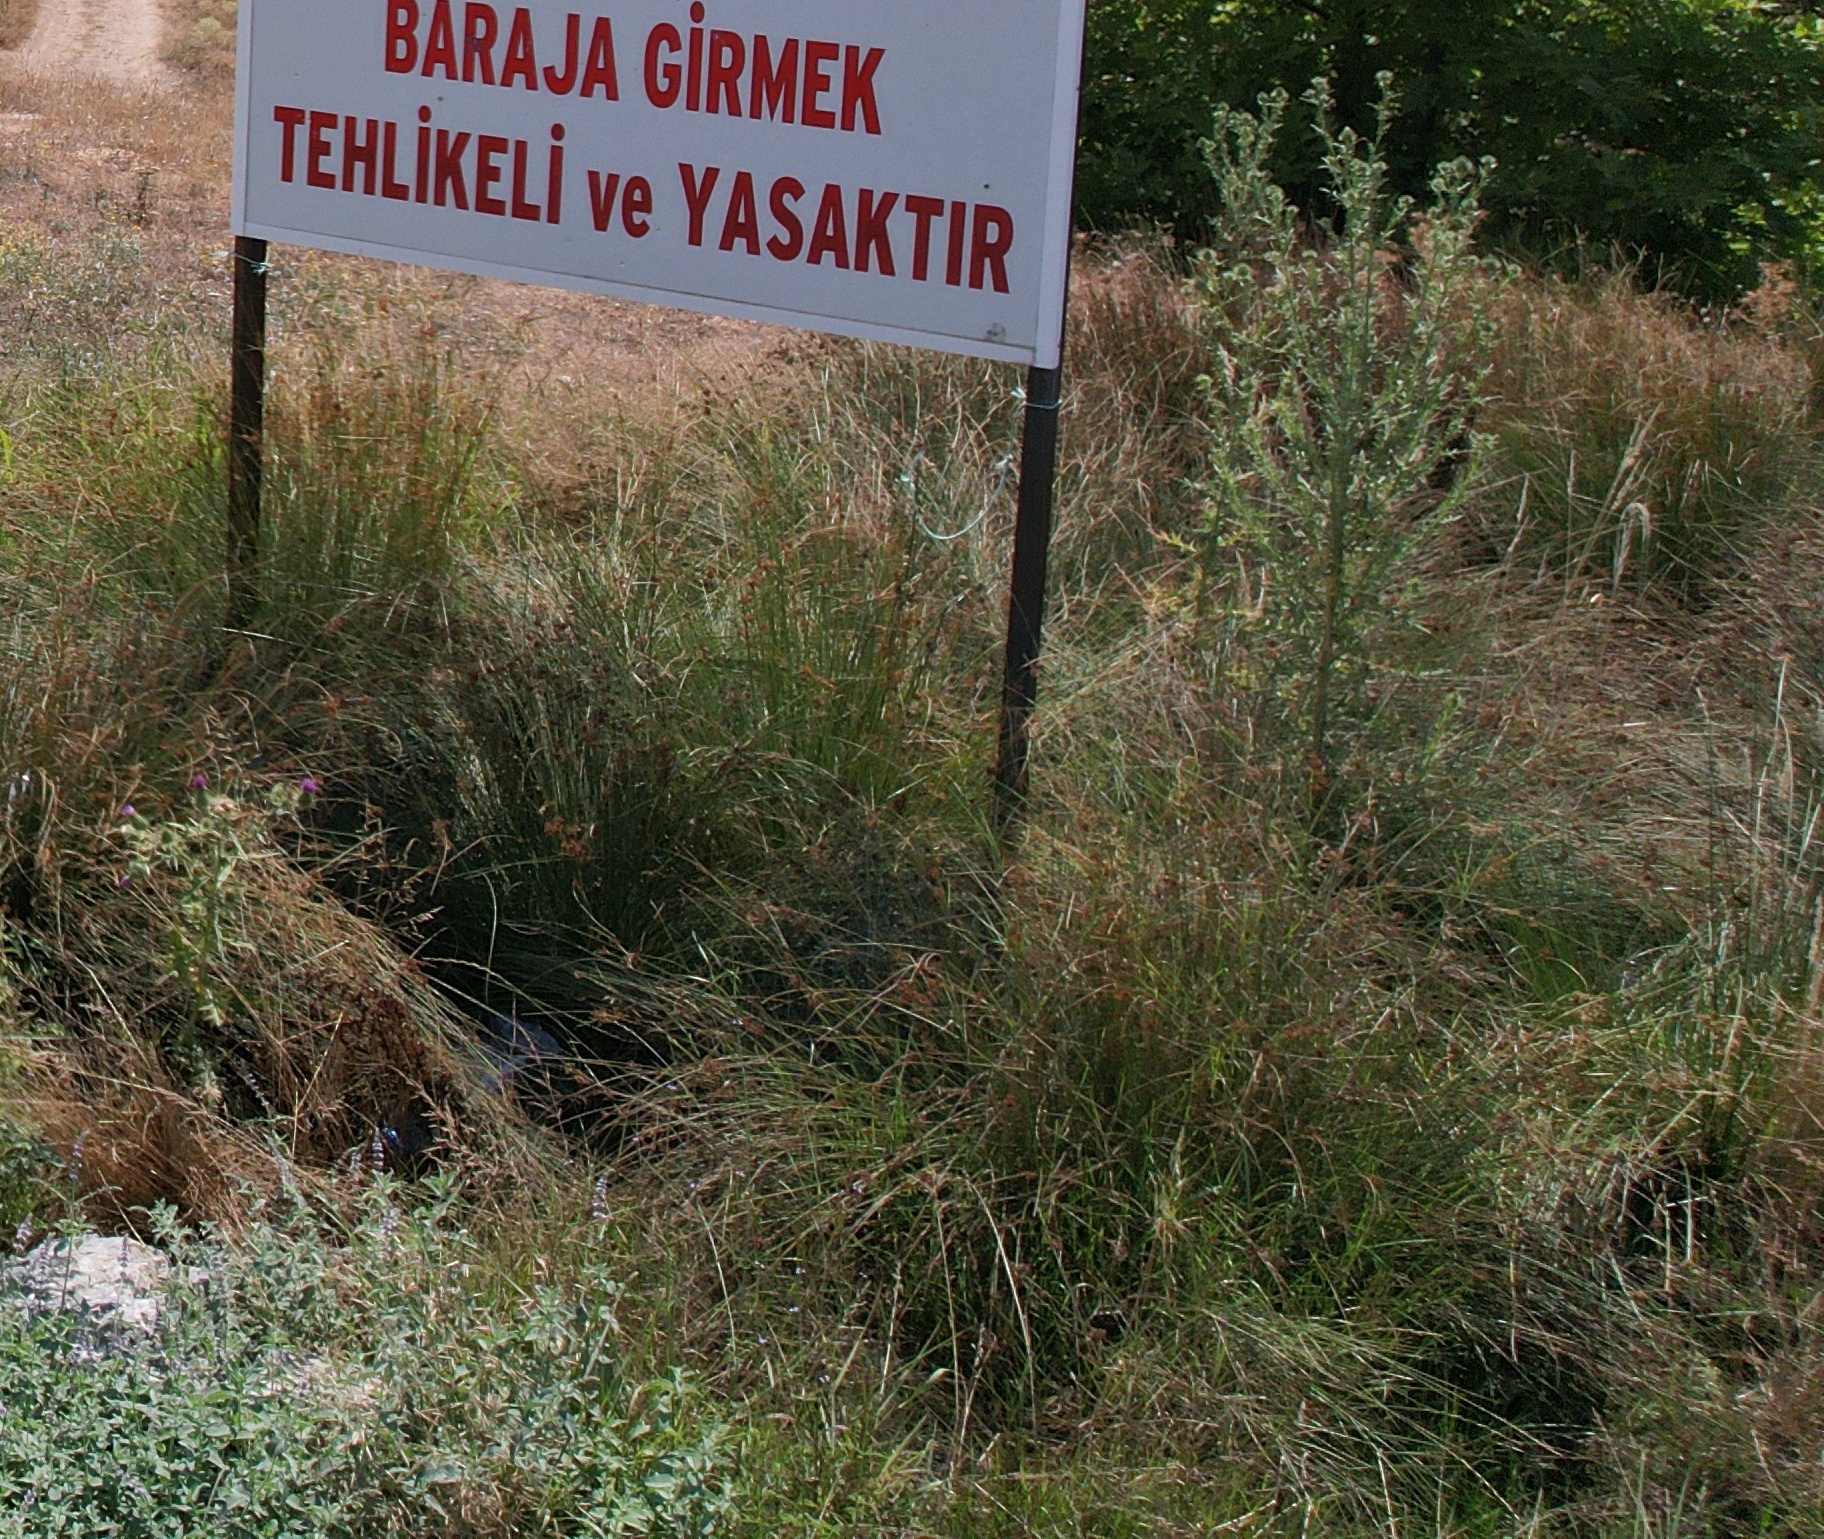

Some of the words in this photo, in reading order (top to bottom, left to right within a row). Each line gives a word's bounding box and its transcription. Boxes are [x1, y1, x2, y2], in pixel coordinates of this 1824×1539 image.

[643, 1, 885, 135] GİRMEK
[273, 105, 565, 225] TEHLİKELİ
[588, 170, 653, 238] ve
[679, 163, 1014, 294] YASAKTIR
